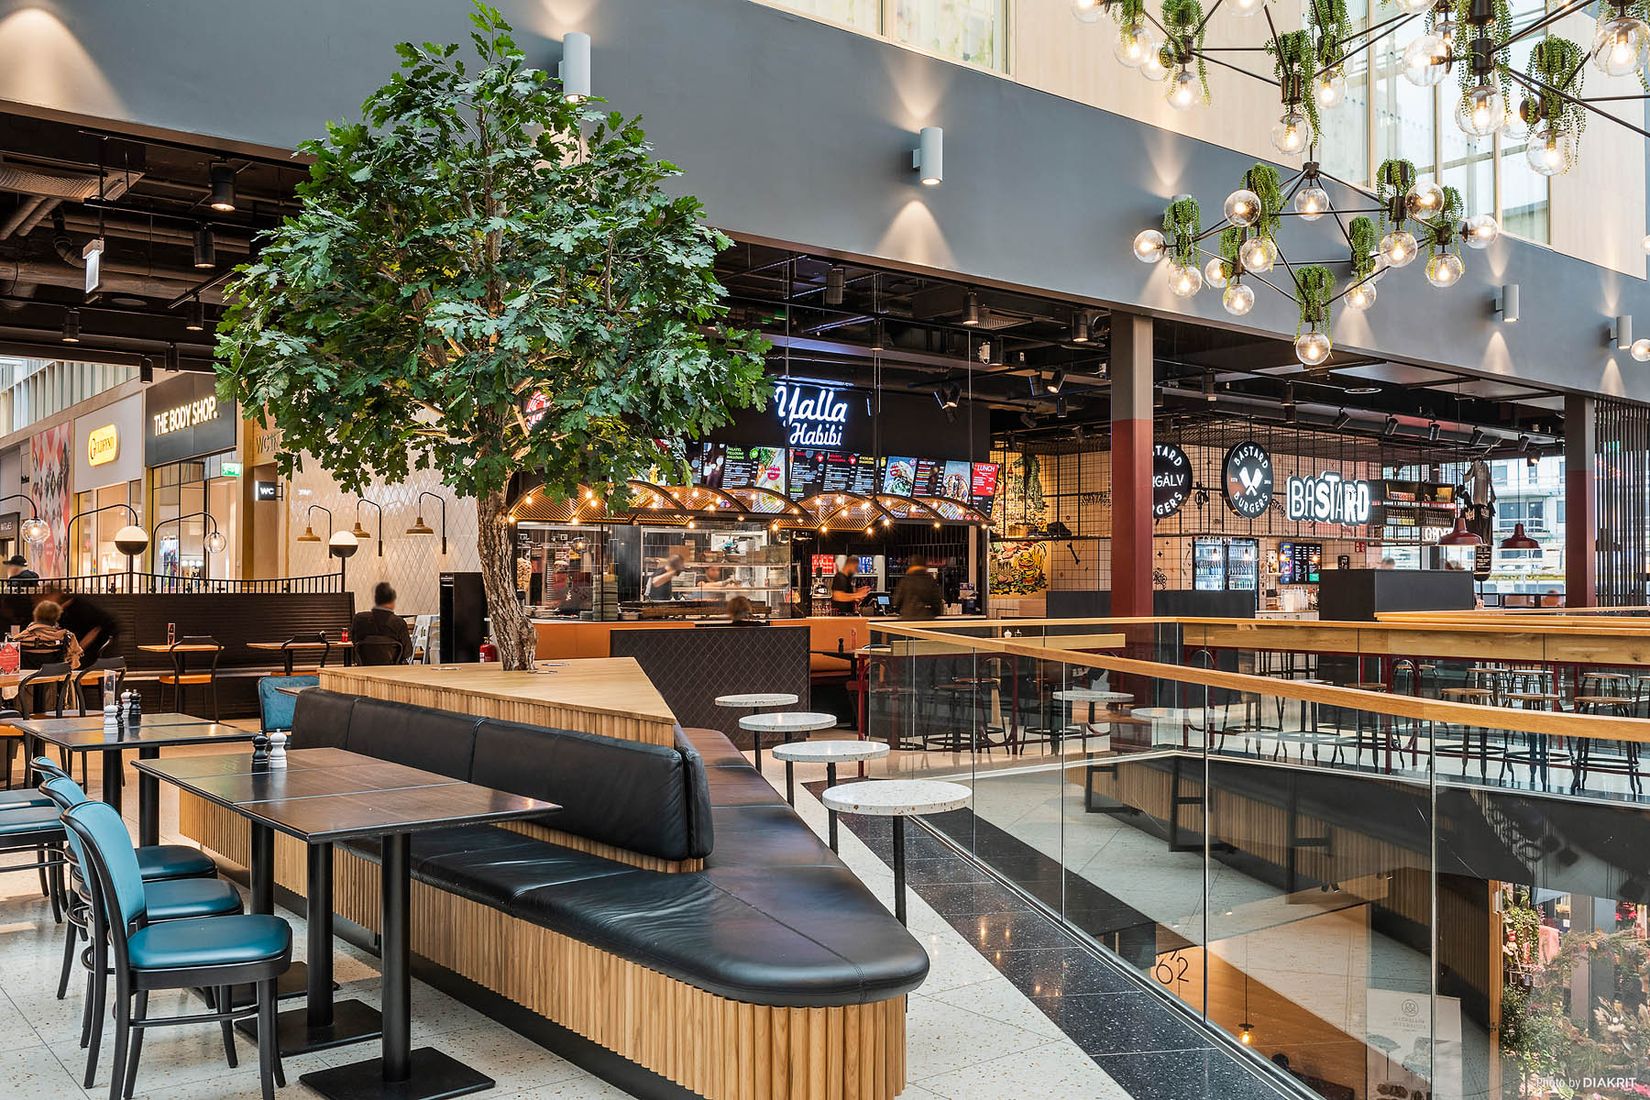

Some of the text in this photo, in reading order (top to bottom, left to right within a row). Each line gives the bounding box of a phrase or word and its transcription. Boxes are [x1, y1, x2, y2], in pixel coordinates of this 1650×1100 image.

[774, 385, 848, 427] Yalla
[154, 411, 170, 436] THE
[169, 403, 192, 432] BODY
[790, 422, 843, 446] Habibi
[1153, 445, 1183, 467] TARD
[1234, 446, 1269, 469] BASTARD
[977, 464, 996, 472] LUNCH
[259, 487, 275, 496] WC
[1153, 491, 1183, 515] GERS
[1234, 491, 1269, 514] BURGERS
[1290, 475, 1369, 523] BASTARD
